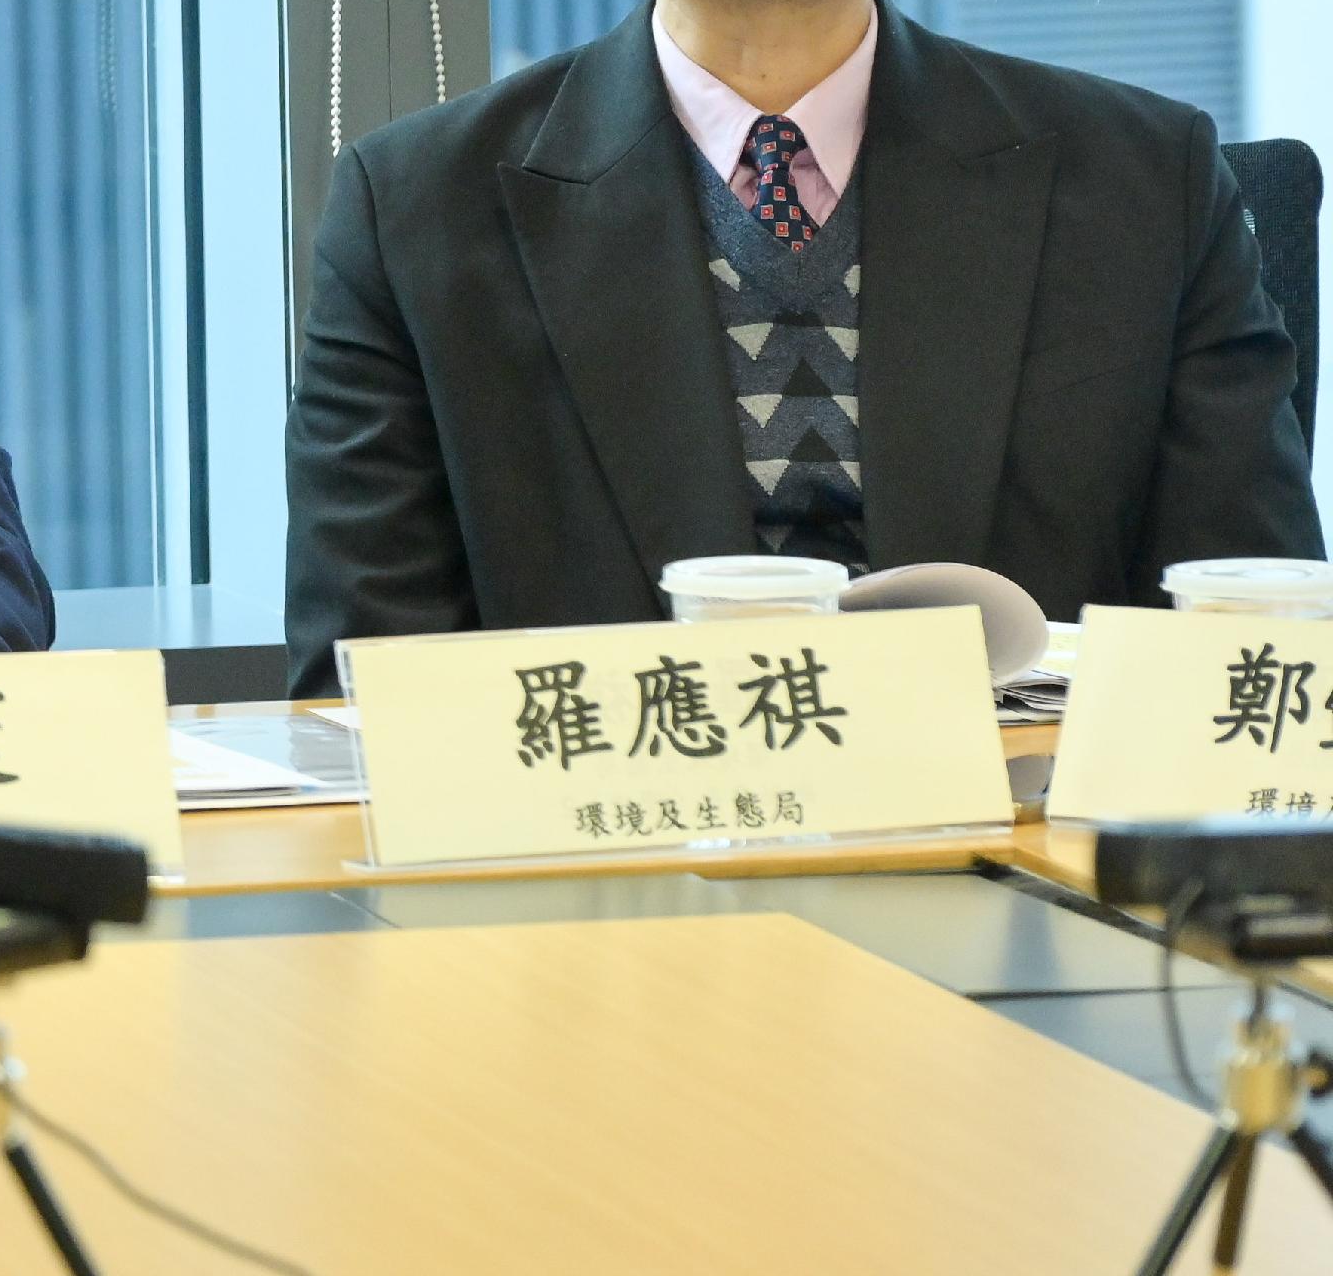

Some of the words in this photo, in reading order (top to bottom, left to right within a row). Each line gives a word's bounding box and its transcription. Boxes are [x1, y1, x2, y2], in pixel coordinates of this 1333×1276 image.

[515, 648, 848, 770] 羅應祺
[1212, 642, 1333, 754] 鄭
[576, 790, 805, 838] 環境及生態局
[1244, 787, 1333, 818] 環境
